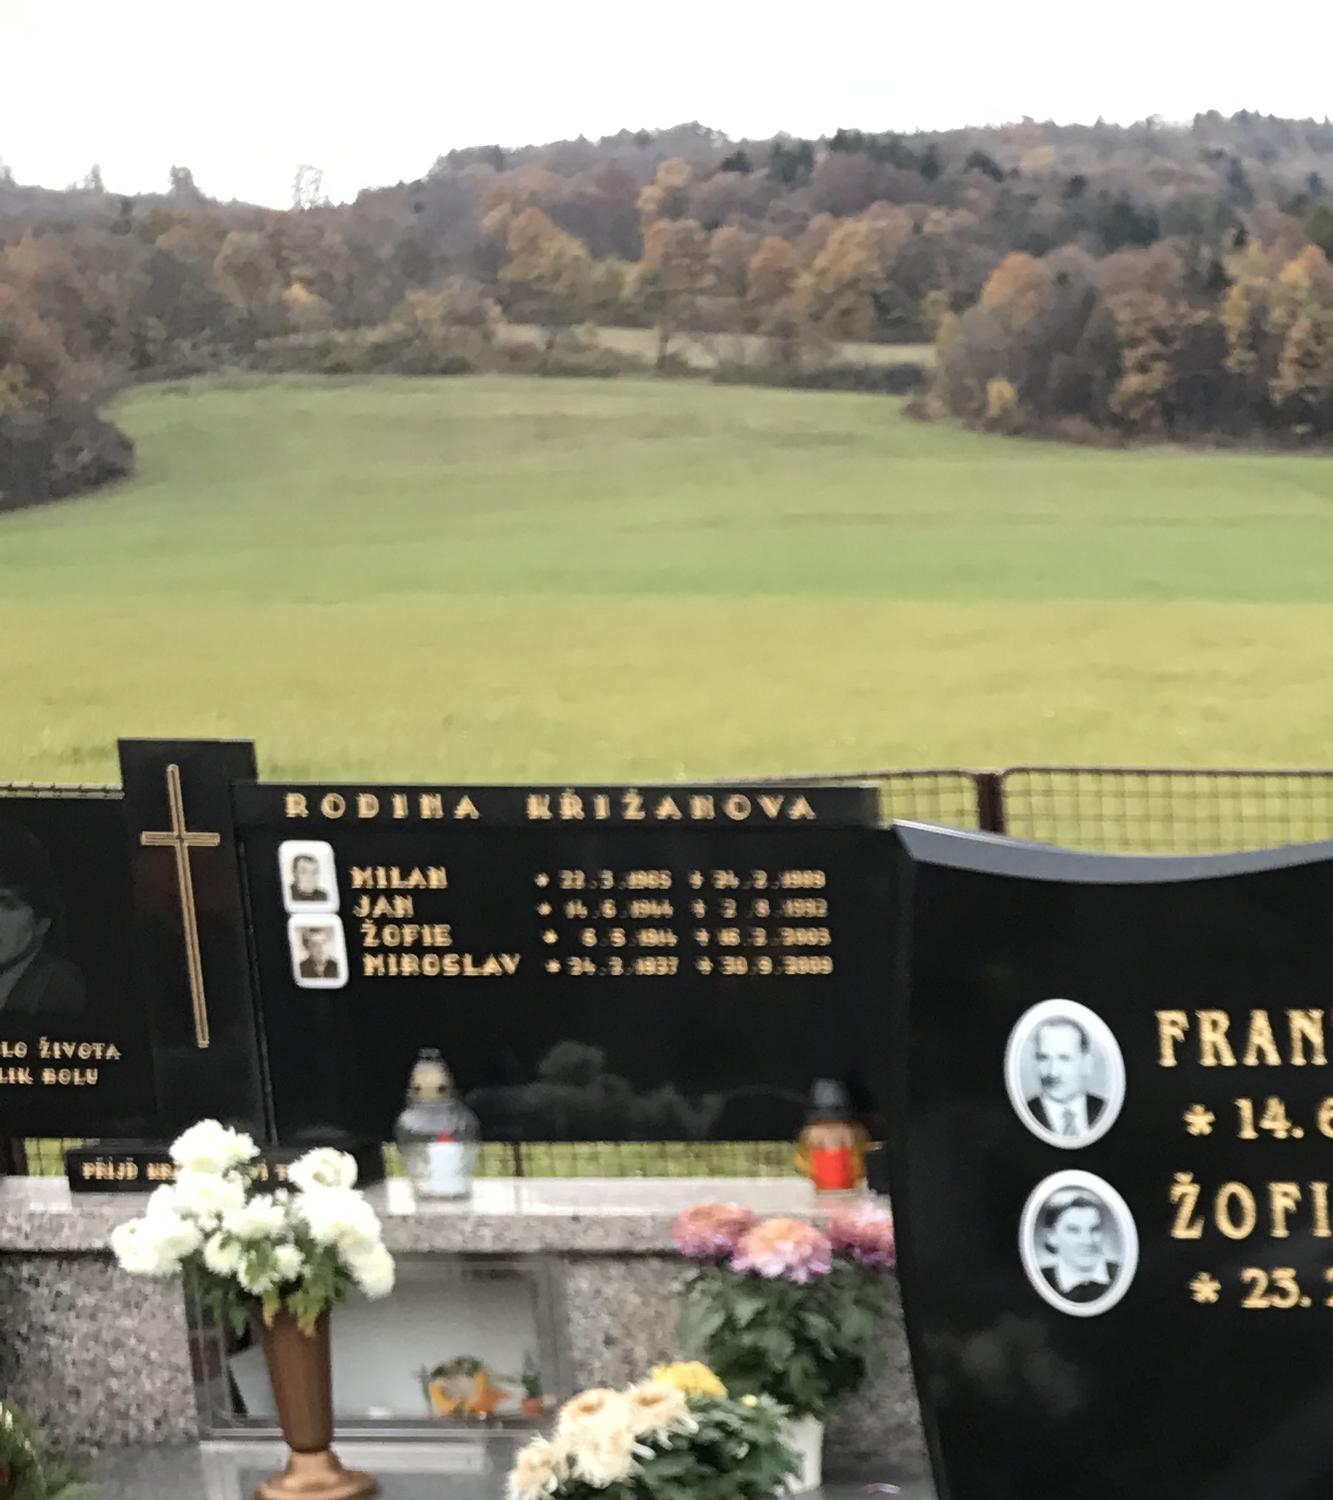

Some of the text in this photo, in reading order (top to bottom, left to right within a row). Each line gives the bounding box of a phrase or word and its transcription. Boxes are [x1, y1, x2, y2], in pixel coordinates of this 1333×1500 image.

[284, 792, 480, 820] RODINA
[351, 866, 448, 889] MILAN
[353, 895, 415, 919] JAN
[361, 919, 453, 947] ŽOFIE
[362, 952, 521, 977] MIROSLAV
[39, 1036, 121, 1060] ŽIVOTA
[42, 1067, 98, 1085] BOLU
